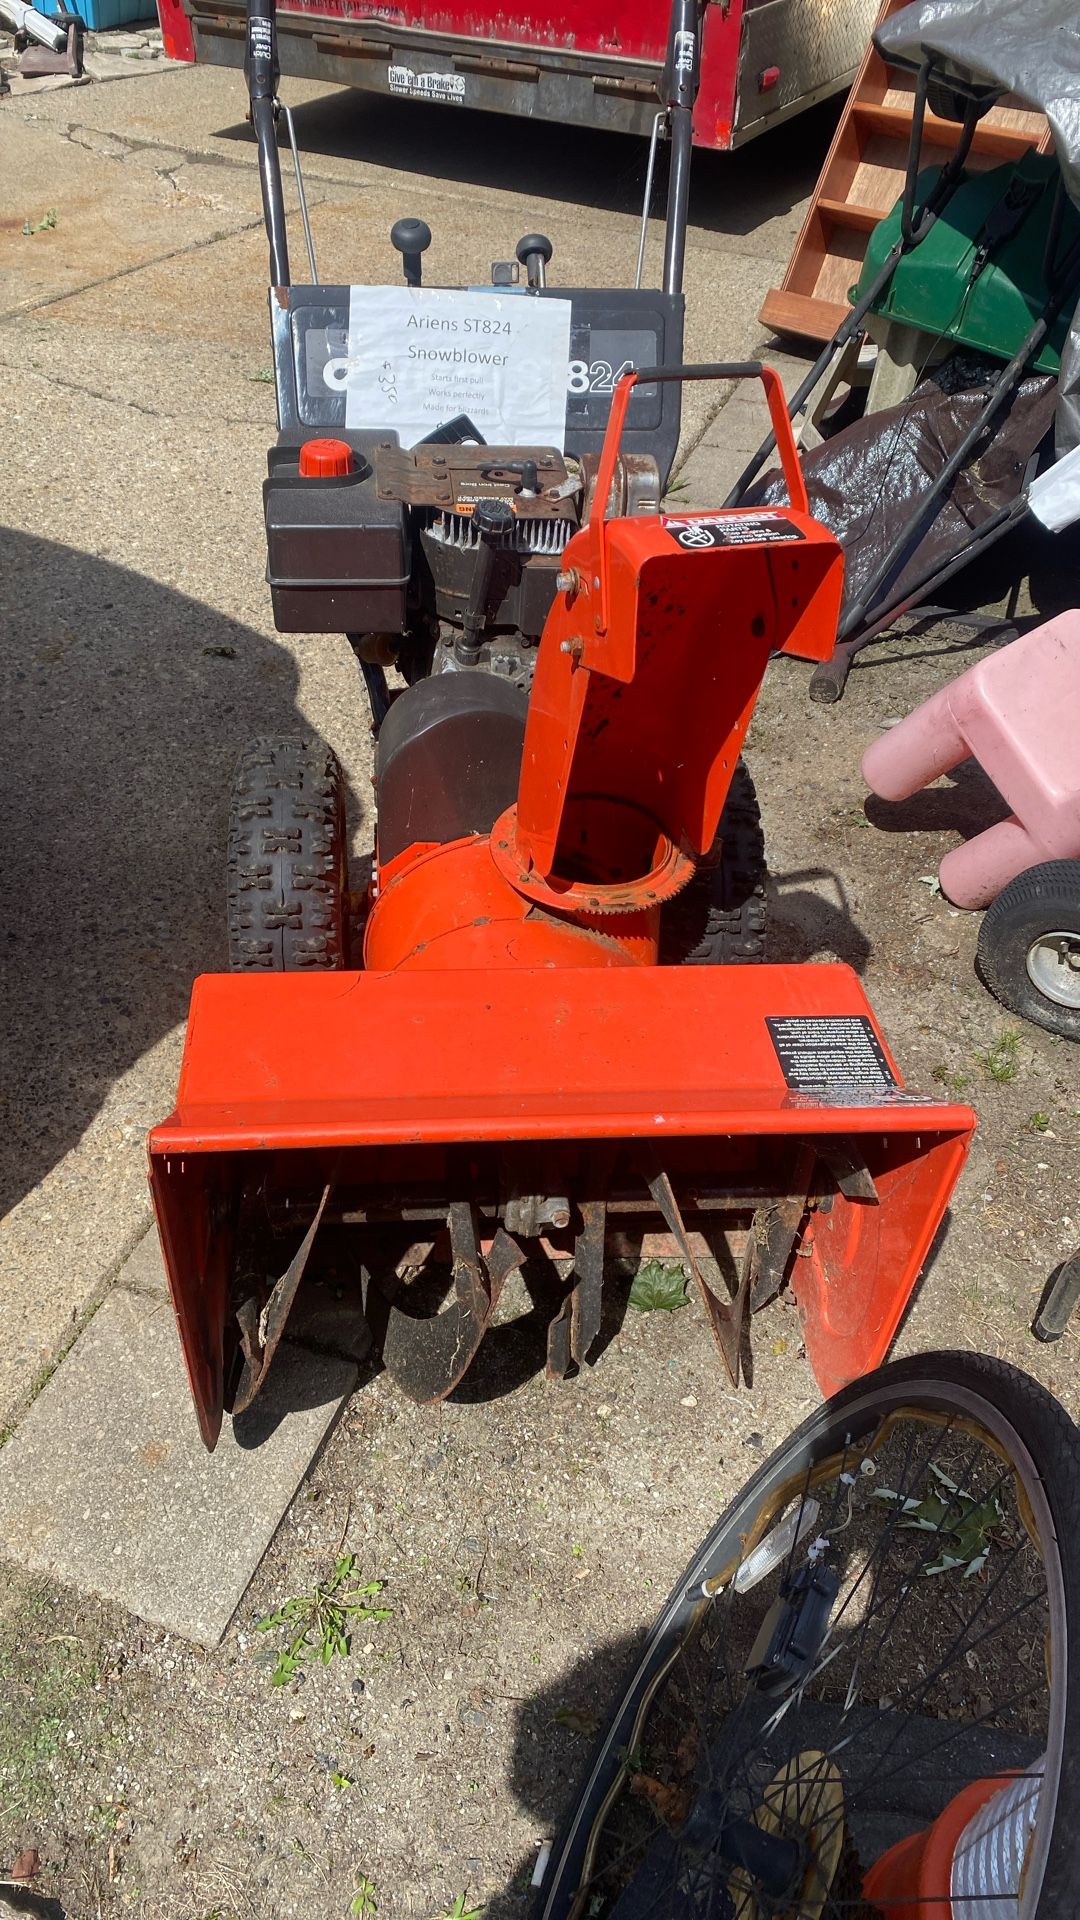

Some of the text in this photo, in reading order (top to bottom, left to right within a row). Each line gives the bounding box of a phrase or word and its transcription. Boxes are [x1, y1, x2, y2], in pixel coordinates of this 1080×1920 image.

[390, 70, 404, 83] Give
[420, 78, 425, 87] a
[427, 76, 450, 90] Brake
[390, 84, 408, 93] Slower
[432, 91, 445, 99] Save
[407, 314, 512, 335] Ariens ST824
[408, 346, 509, 366] Snowblower
[431, 374, 484, 385] Starts first pull
[428, 388, 485, 401] Works perfectly
[423, 403, 489, 416] Made for blizzards
